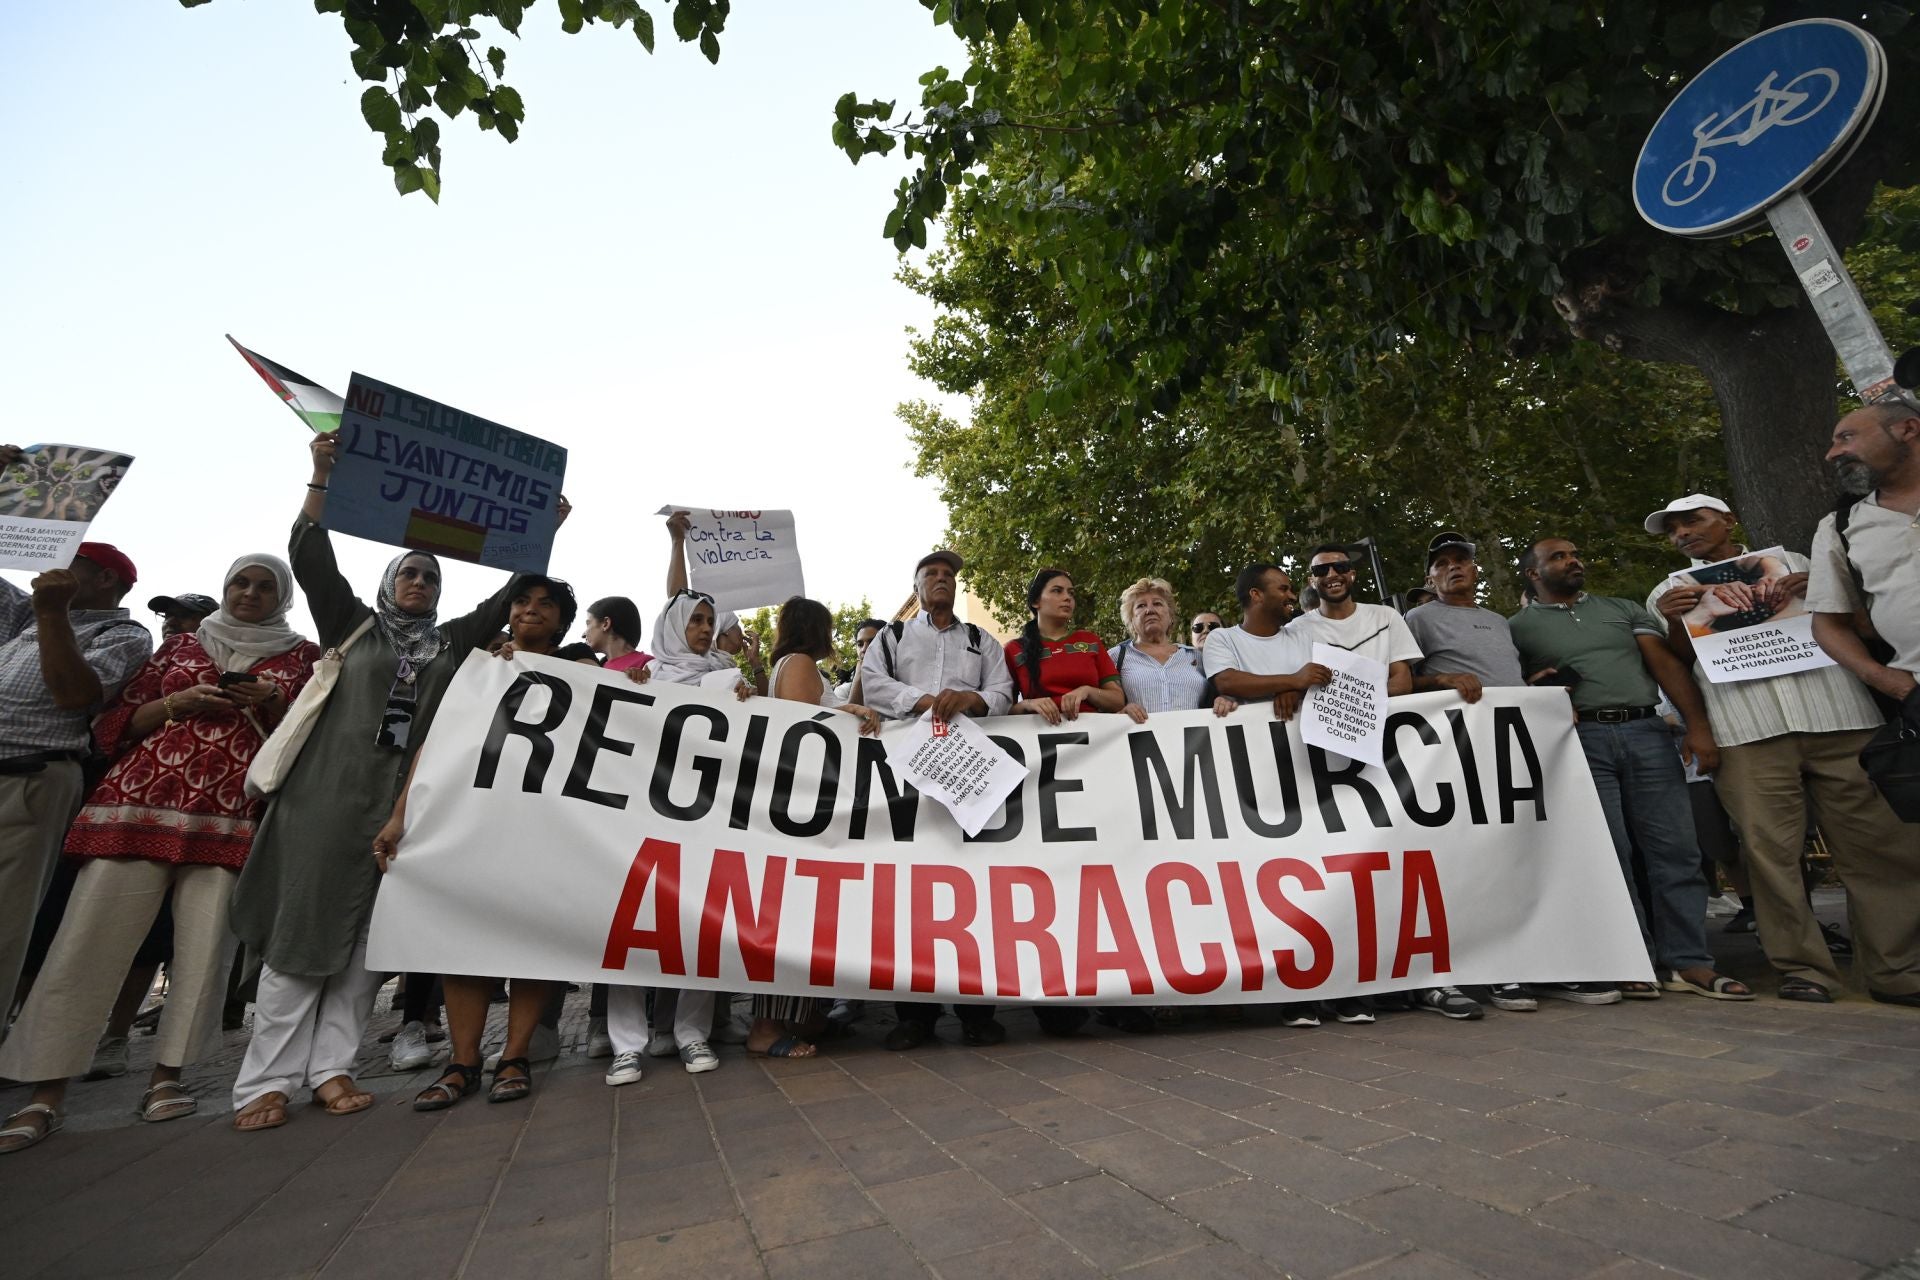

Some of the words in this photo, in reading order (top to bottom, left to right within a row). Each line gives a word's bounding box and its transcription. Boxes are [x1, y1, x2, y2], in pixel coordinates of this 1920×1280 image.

[346, 383, 385, 417] NO
[382, 388, 564, 477] ISLAMOFOBIA
[346, 424, 552, 510] LEVANTEMOS
[380, 470, 532, 534] JUNTOS
[37, 528, 77, 537] MAYORES
[18, 551, 57, 559] LABORAL
[1723, 636, 1796, 655] VERDADERA
[1728, 628, 1783, 646] NUESTRA
[1712, 644, 1800, 666] NACIONALIDAD
[1802, 641, 1818, 650] ES
[1723, 663, 1739, 672] LA
[1741, 651, 1814, 670] HUMANIDAD
[1338, 681, 1349, 690] LA
[1351, 686, 1372, 700] RAZA
[1341, 672, 1376, 692] IMPORTA
[1314, 692, 1325, 702] LA
[1327, 697, 1377, 721] OSCURIDAD
[1320, 686, 1338, 697] QUE
[1363, 701, 1375, 711] EN
[1312, 702, 1342, 719] TODOS
[1343, 713, 1376, 730] SOMOS
[1318, 714, 1334, 726] DEL
[1336, 720, 1367, 737] MISMO
[1326, 726, 1357, 743] COLOR
[473, 670, 919, 842] REGIÓN
[963, 731, 1097, 843] DE
[1128, 706, 1548, 841] MURCIA
[909, 742, 929, 768] ESPERO
[913, 743, 941, 775] PERSONAS
[922, 752, 945, 777] CUENTA
[942, 741, 956, 753] QUE
[953, 731, 963, 742] DE
[930, 766, 944, 780] QUE
[941, 751, 957, 767] SOLO
[955, 738, 968, 752] HAY
[937, 770, 951, 785] UNA
[949, 755, 966, 771] RAZA:
[964, 745, 974, 755] LA
[942, 775, 959, 791] RAZA
[957, 750, 982, 776] HUMANA.
[952, 783, 974, 806] SOMOS
[971, 765, 991, 785] PARTE
[988, 756, 998, 767] DE
[955, 776, 969, 791] QUE
[966, 756, 987, 778] TODOS
[974, 780, 990, 796] ELLA
[602, 838, 1452, 997] ANTIRRACISTA
